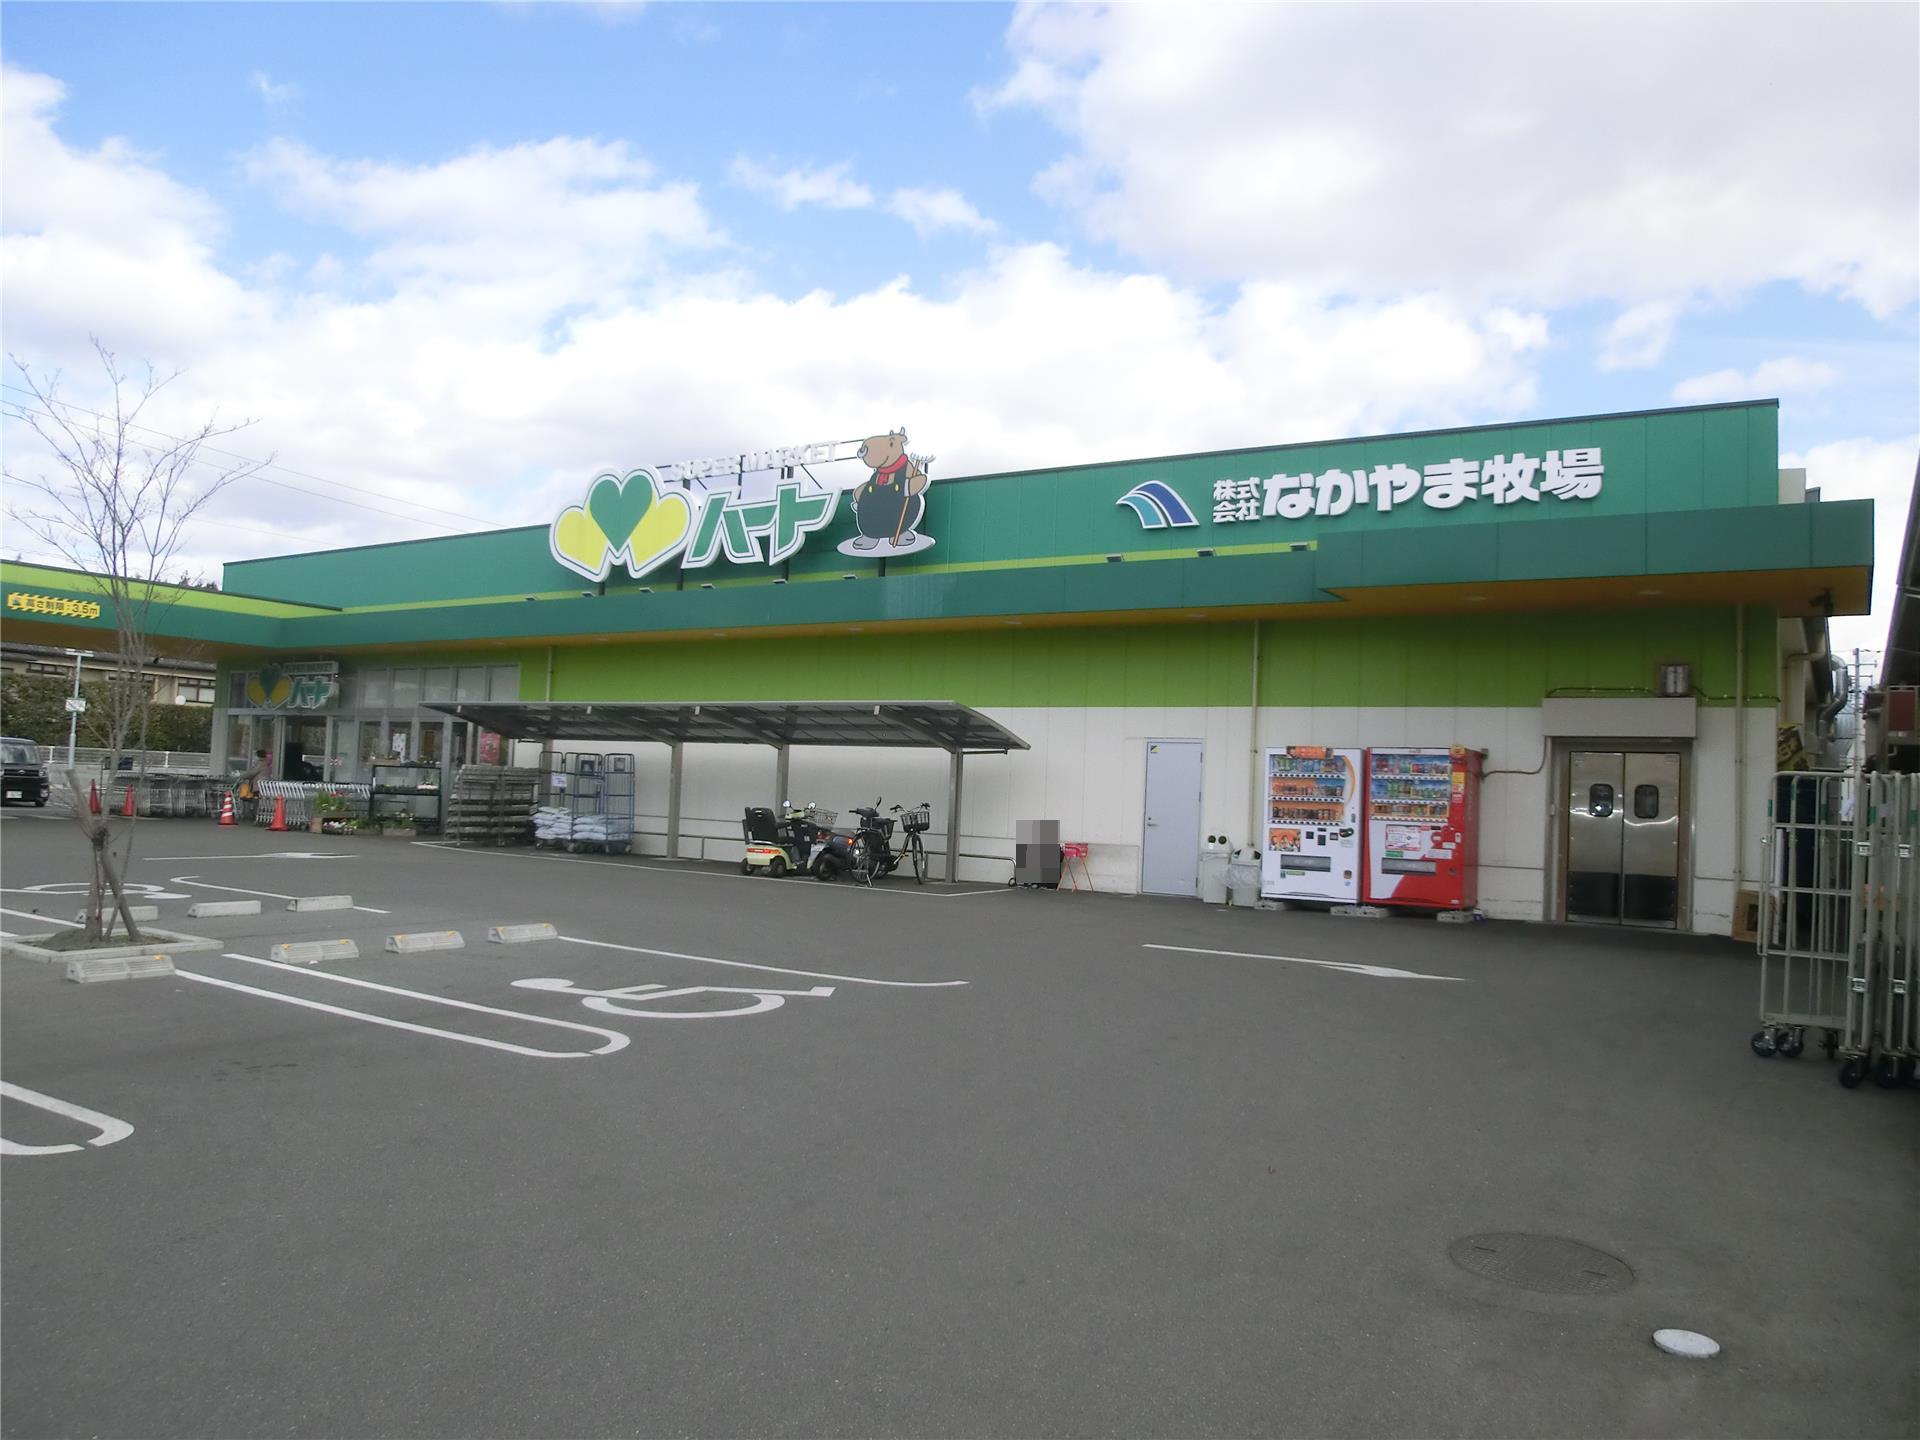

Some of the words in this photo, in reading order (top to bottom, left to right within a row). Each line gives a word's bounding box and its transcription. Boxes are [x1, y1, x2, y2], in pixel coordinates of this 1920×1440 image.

[672, 455, 741, 481] SUPER
[744, 442, 840, 472] MARKET
[1213, 477, 1260, 501] 株式
[1262, 448, 1604, 518] なかやま牧場
[682, 486, 840, 568] ハート
[1213, 500, 1260, 523] 会社
